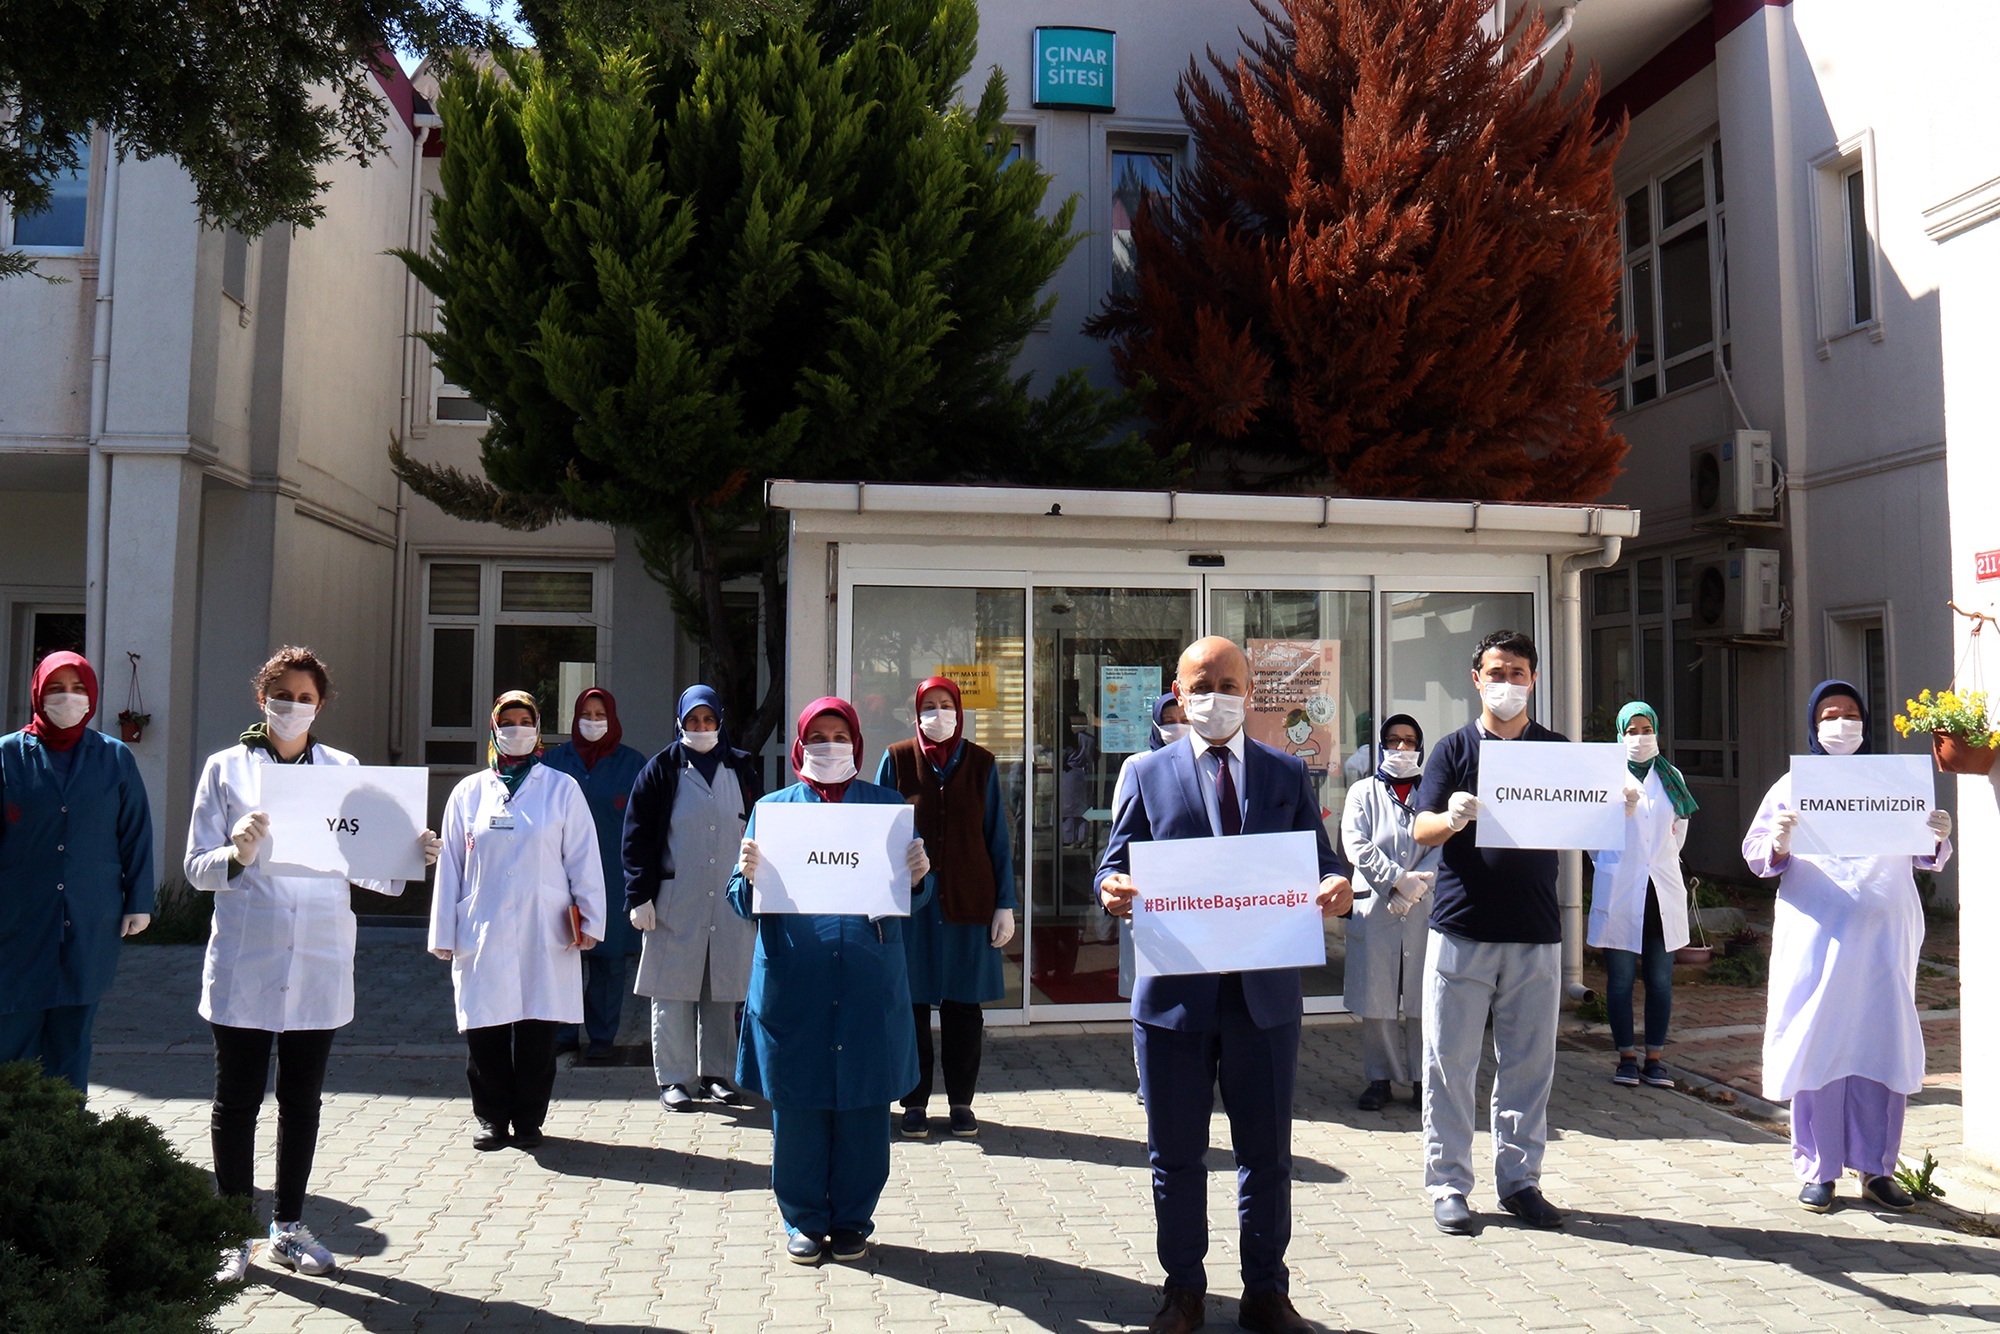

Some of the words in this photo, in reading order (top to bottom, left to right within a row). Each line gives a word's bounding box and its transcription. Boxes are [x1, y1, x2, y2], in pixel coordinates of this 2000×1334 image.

[1045, 46, 1107, 67] ÇINAR
[1048, 65, 1103, 87] SİTESİ
[1977, 556, 2000, 575] 211
[1254, 659, 1295, 667] korumak
[1300, 669, 1332, 679] yerlerde
[1254, 705, 1287, 714] kapatın.
[1495, 786, 1608, 804] ÇINARLARIMIZ
[1800, 796, 1926, 811] EMANETİMİZDİR
[326, 818, 360, 836] YAŞ
[807, 851, 860, 869] ALMIŞ
[1144, 890, 1308, 913] #BirlikteBaşaracağız
